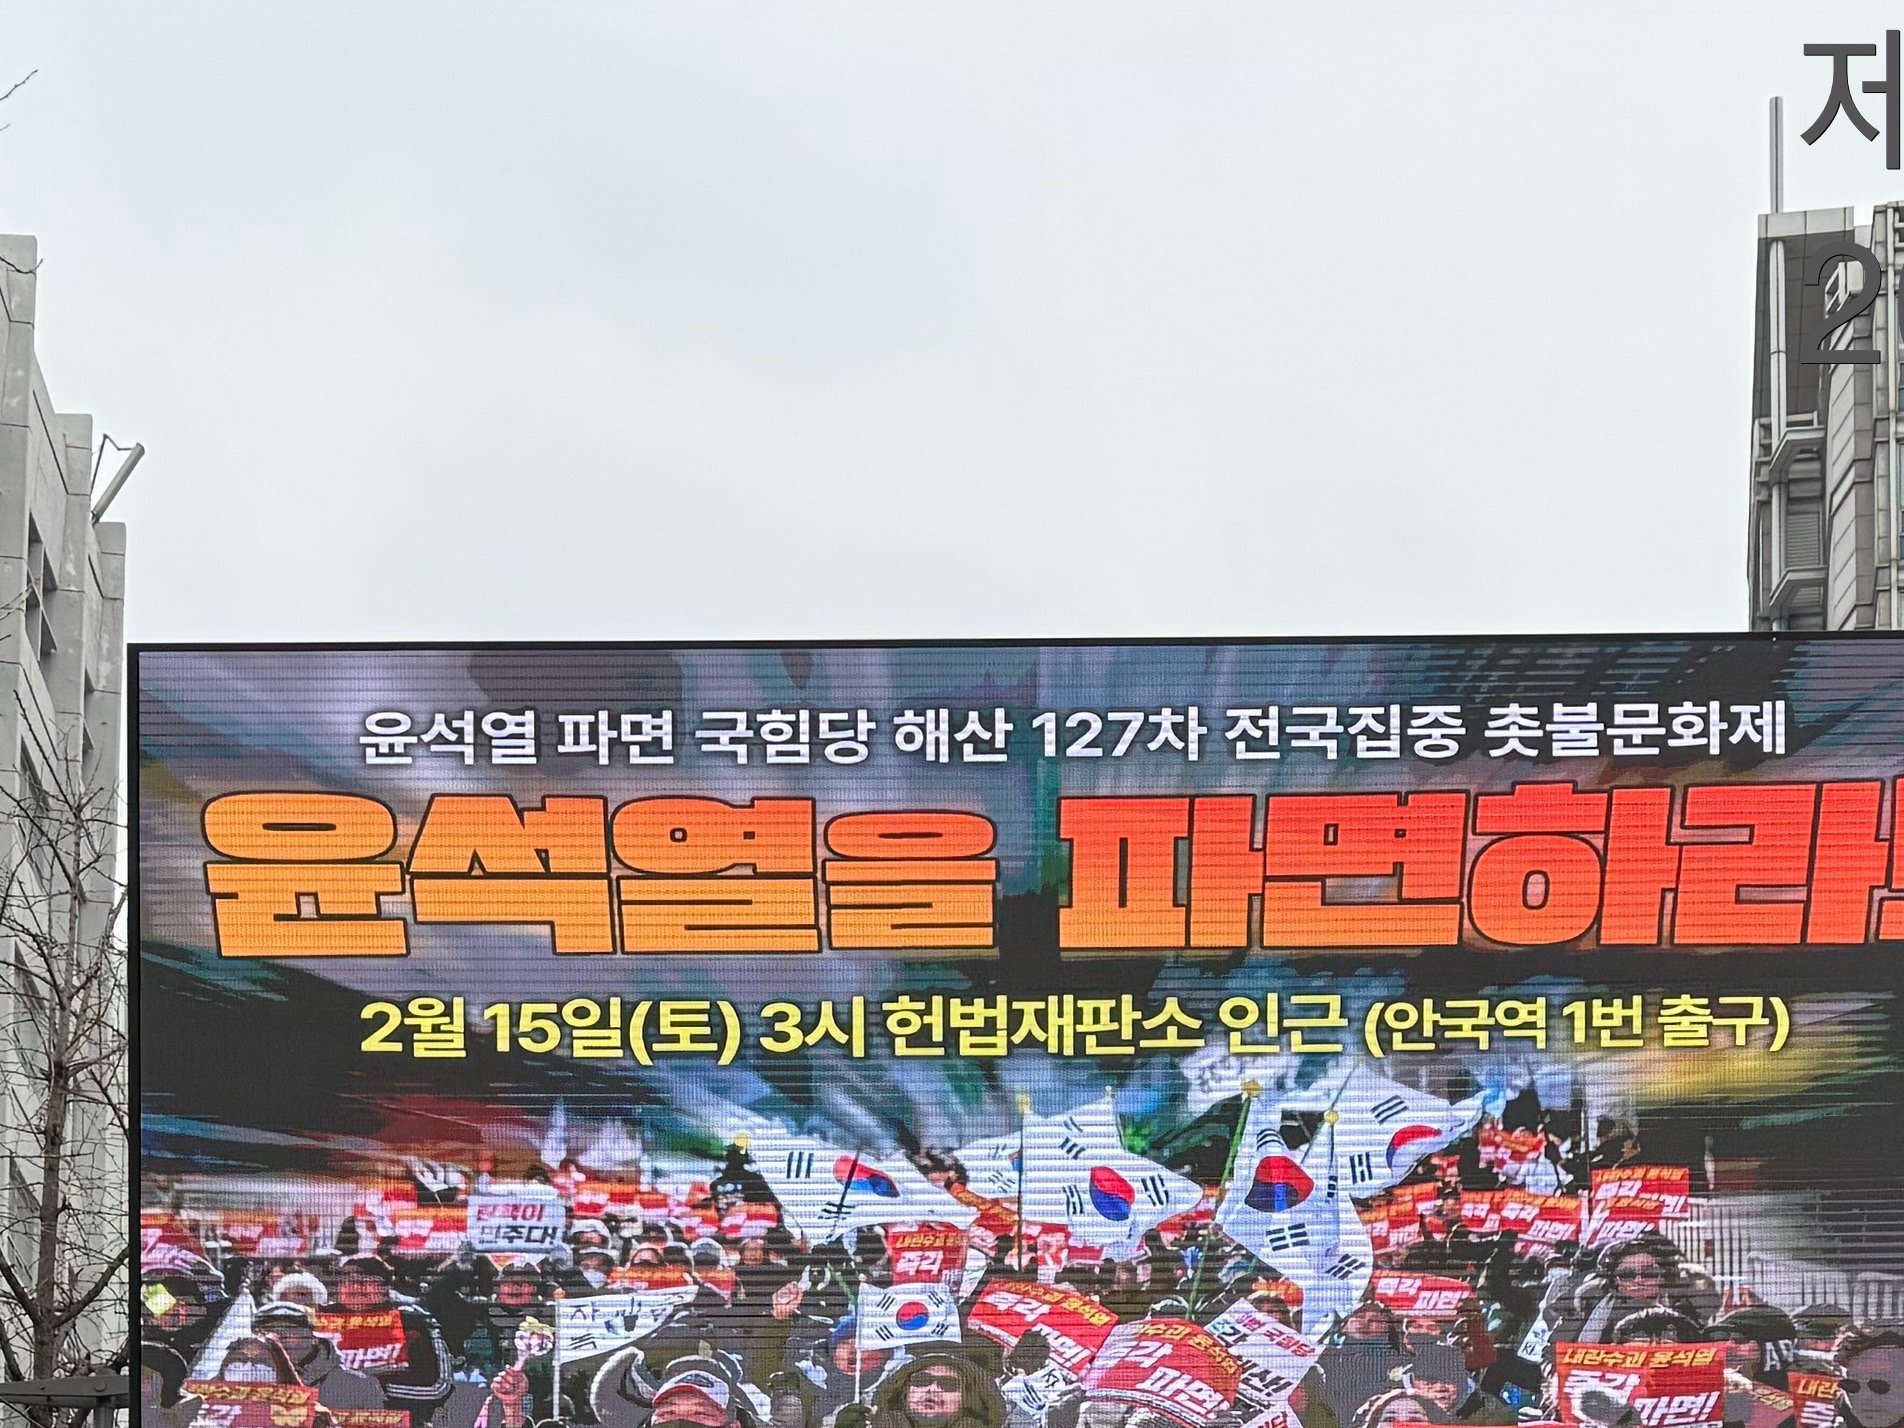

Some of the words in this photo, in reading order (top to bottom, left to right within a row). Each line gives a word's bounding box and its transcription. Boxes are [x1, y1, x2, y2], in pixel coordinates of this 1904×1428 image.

[359, 709, 537, 767] 윤석열
[556, 709, 676, 765] 파면
[694, 708, 876, 764] 국힘당
[894, 707, 1014, 763] 해산
[1032, 704, 1208, 763] 127차
[1224, 703, 1467, 759] 전국집중
[1484, 699, 1787, 757] 촛불문화제
[201, 790, 1000, 958] 윤석열을
[359, 996, 467, 1055] 2월
[486, 997, 743, 1067] 15일(토)
[759, 995, 865, 1057] 3시
[884, 994, 1206, 1057] 헌법재판소
[1220, 993, 1349, 1053] 인근
[1364, 994, 1548, 1057] (안국역
[1564, 994, 1644, 1048] 1번
[1658, 992, 1791, 1054] 출구)
[1562, 1346, 1646, 1367] 내란수괴
[1649, 1346, 1717, 1368] 윤석열
[1635, 1391, 1721, 1427] 파면!
